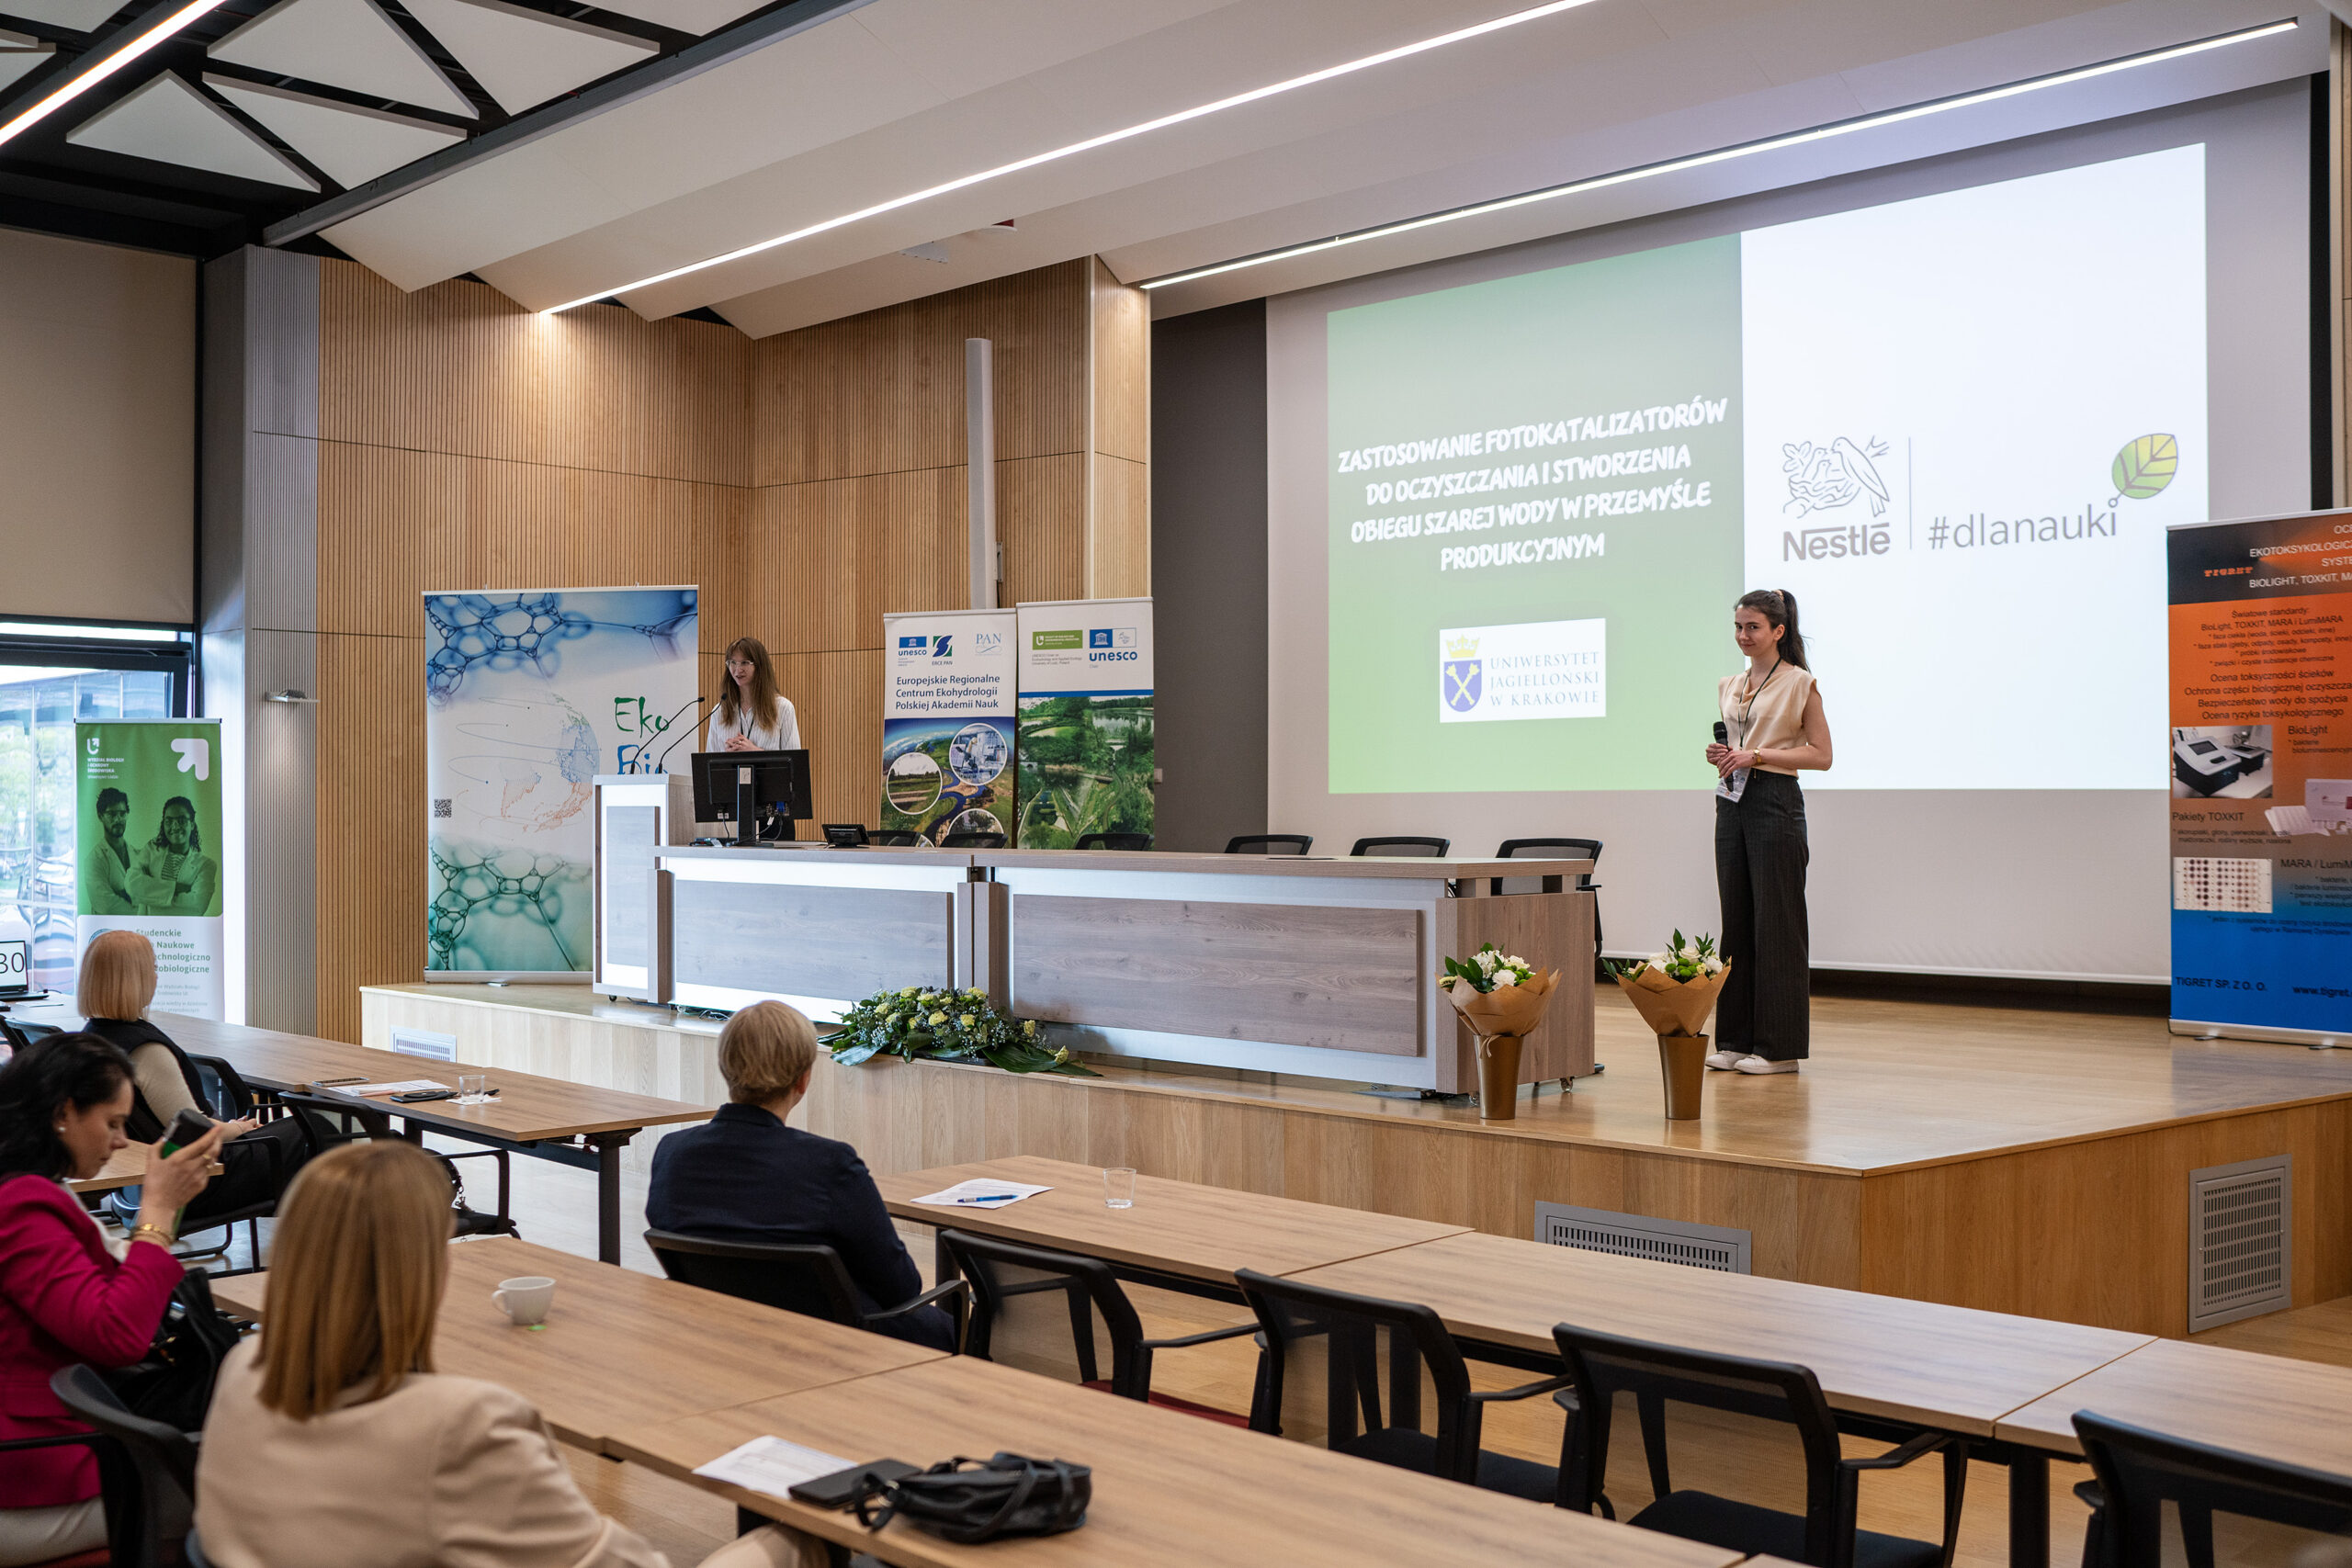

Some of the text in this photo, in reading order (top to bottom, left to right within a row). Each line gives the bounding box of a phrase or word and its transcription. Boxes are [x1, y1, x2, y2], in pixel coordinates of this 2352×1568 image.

[1338, 395, 1728, 473] ZASTOSOWANIE FOTOKATALIZATORÓW
[1366, 444, 1691, 505] DO OCZYSZCZANIA I STWORZENIA
[1351, 479, 1712, 543] OBIEGU SZAREJ WODY W PRZEMYŚLE
[1928, 498, 2118, 550] #dlanauki
[1441, 533, 1605, 570] PRODUKCYJNYM
[2204, 566, 2254, 577] TIGRET
[2267, 618, 2293, 626] MARA
[2299, 615, 2344, 625] LumiMARA
[976, 633, 1002, 645] PAN
[1089, 651, 1137, 661] unesco
[1489, 650, 1600, 670] UNIWERSYTET
[897, 673, 1001, 686] Europejskie Regionalne
[1488, 668, 1600, 690] JAGIELLOŃSKI
[2211, 673, 2238, 682] Ocena
[896, 687, 998, 698] Centrum Ekohydrologii
[2184, 686, 2221, 696] Ochrona
[1489, 690, 1600, 706] W KRAKOWIE
[2198, 694, 2348, 708] Bezpieczeństwo wody do spożycia
[896, 699, 999, 712] Polskiej Akademii Nauk
[615, 696, 669, 739] Eko
[2201, 707, 2345, 720] Ocena ryzyka toksykologicznego
[2288, 725, 2328, 736] BioLight
[617, 744, 669, 774] Bi
[2172, 812, 2245, 823] Pakiety TOXKIT
[2280, 859, 2312, 868] MARA
[156, 941, 195, 949] Naukowe
[2175, 976, 2212, 987] TIGRET
[2233, 980, 2242, 989] Z
[2292, 986, 2352, 998] www.tigret.
